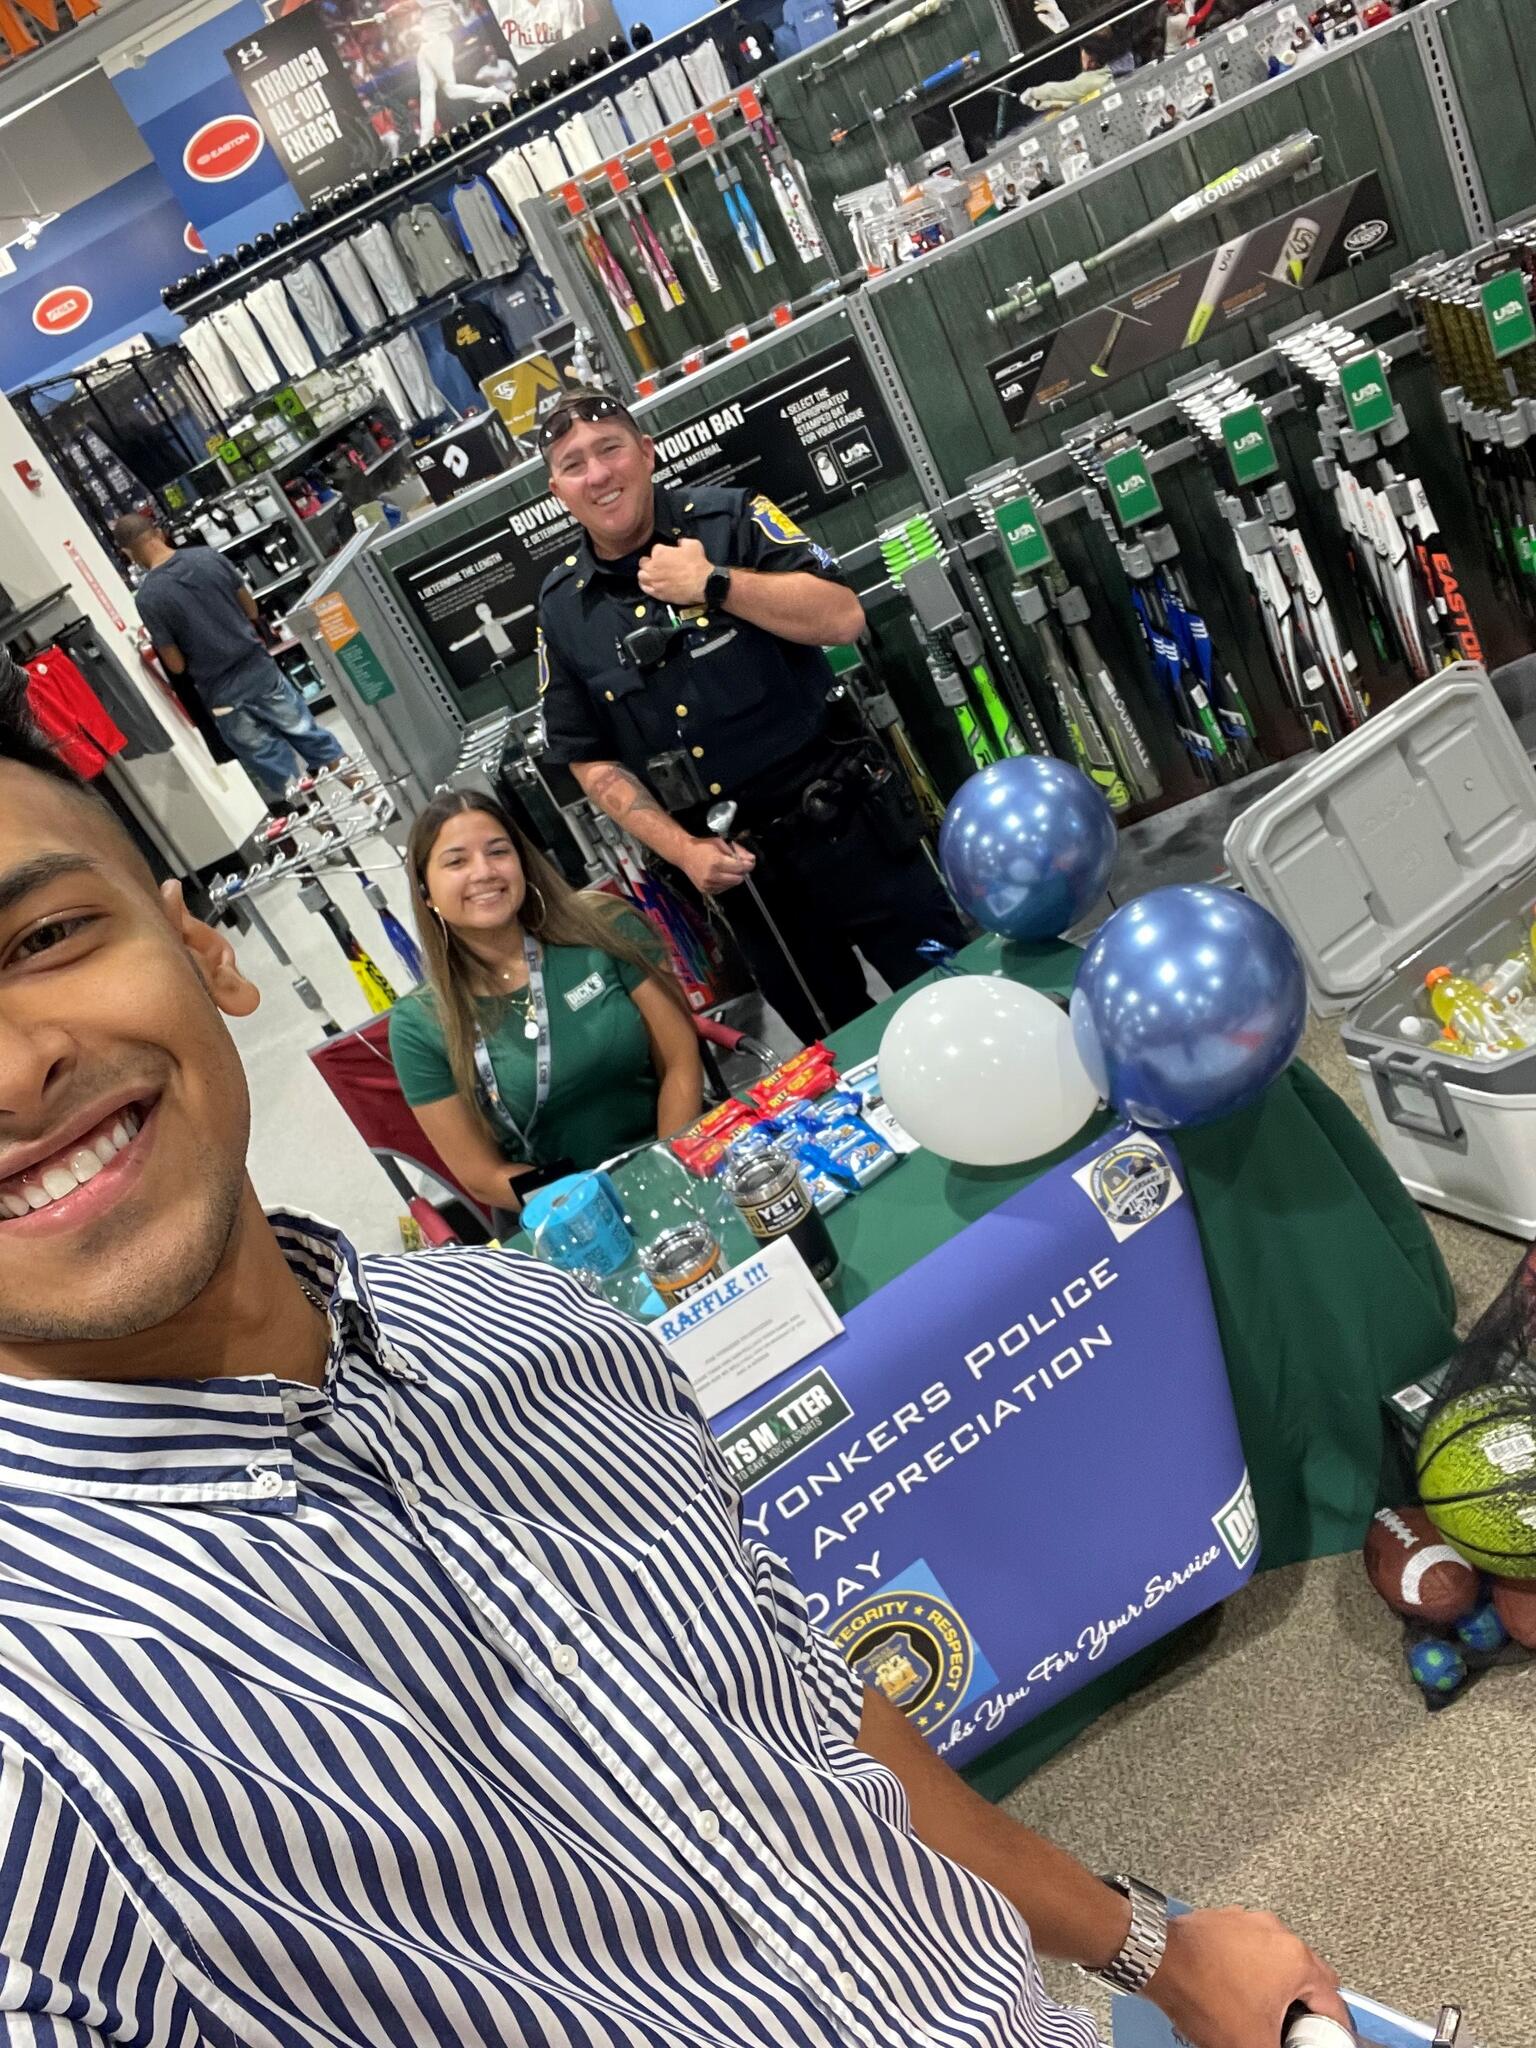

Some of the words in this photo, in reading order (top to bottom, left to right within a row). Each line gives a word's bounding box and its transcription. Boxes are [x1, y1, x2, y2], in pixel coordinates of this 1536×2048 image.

[251, 46, 329, 107] THROUGH
[267, 81, 331, 136] ALL-OUT
[209, 132, 250, 158] EASTON
[280, 110, 343, 164] ENERGY
[1196, 147, 1284, 209] LOUISVILLE
[786, 394, 815, 416] SELECT
[814, 387, 830, 402] THE
[792, 389, 849, 426] APPROPRIATELY
[796, 411, 833, 436] STAMPED
[830, 403, 847, 420] BAT
[800, 431, 818, 446] FOR
[815, 421, 838, 438] YOUR
[835, 407, 865, 429] LEAGUE
[653, 420, 713, 463] YOUTH
[708, 402, 745, 436] BAT
[670, 459, 688, 474] THE
[685, 442, 723, 467] MATERIAL
[460, 563, 476, 580] THE
[473, 552, 503, 574] LENGTH
[1110, 691, 1150, 769] LOUISVILLE
[566, 975, 604, 1009] DICK'S
[762, 1071, 784, 1088] RITZ
[768, 1090, 789, 1108] RITZ
[758, 1190, 799, 1221] YETI
[660, 1277, 744, 1341] RAFFLE
[742, 1381, 952, 1537] YONKERS
[963, 1257, 1120, 1380] POLICE
[746, 1455, 768, 1475] SAVE
[791, 1416, 823, 1442] SPORTS
[813, 1324, 1114, 1560] APPRECIATION
[804, 1550, 882, 1625] DAY
[835, 1601, 909, 1649] TEGRITY
[927, 1609, 964, 1691] RESPECT
[974, 1686, 1031, 1732] You
[1026, 1650, 1079, 1685] For
[1077, 1604, 1142, 1660] Your
[1144, 1545, 1221, 1609] Service
